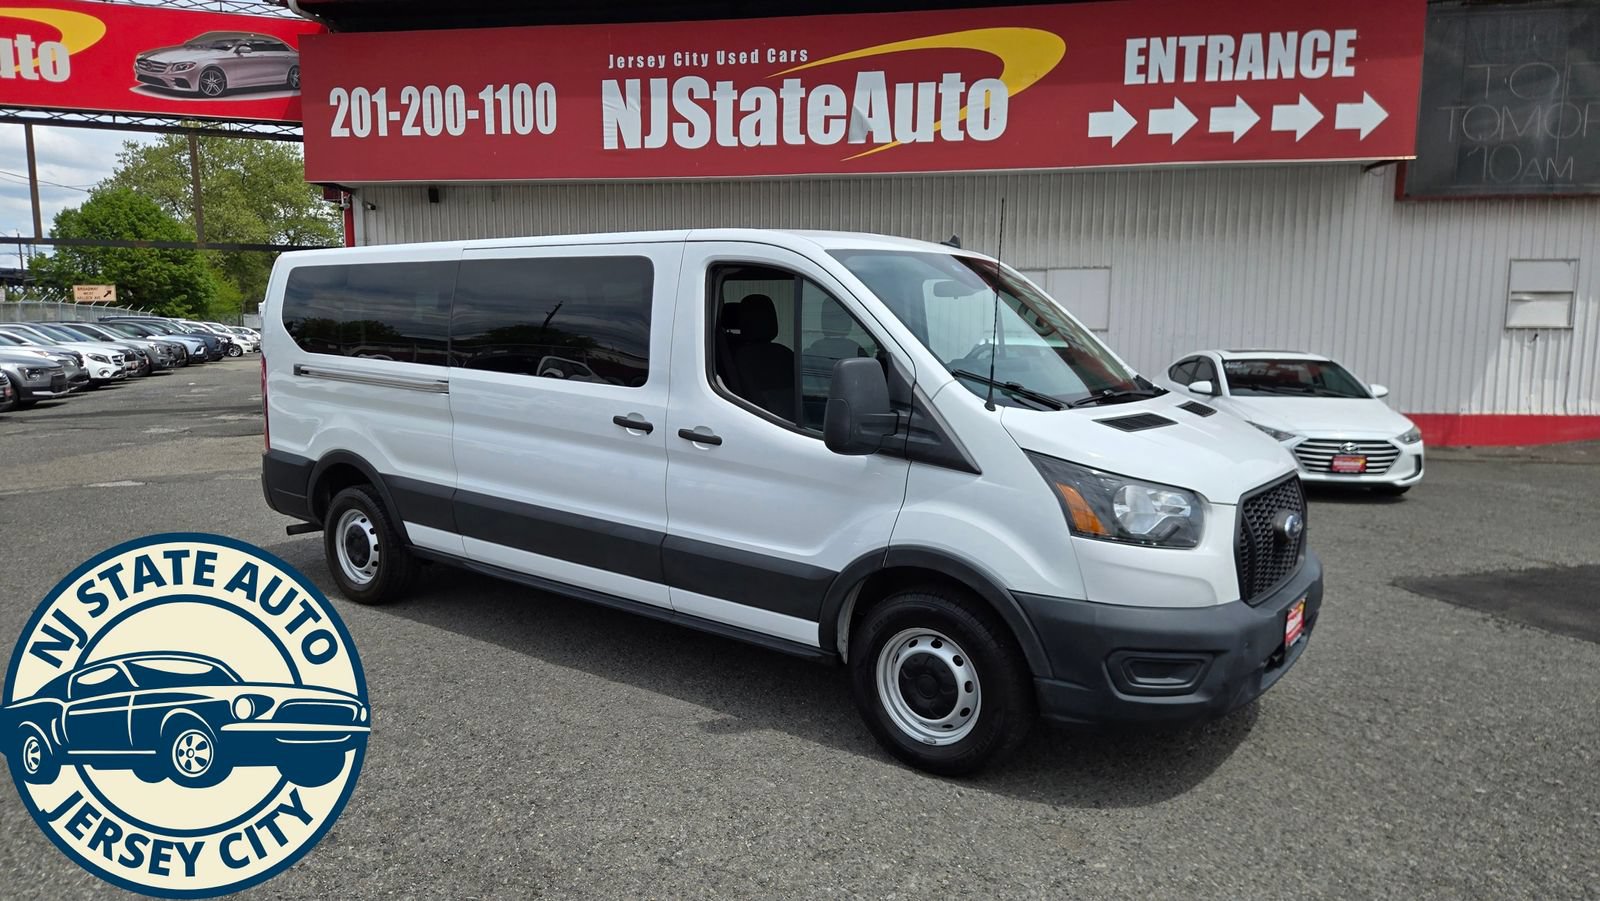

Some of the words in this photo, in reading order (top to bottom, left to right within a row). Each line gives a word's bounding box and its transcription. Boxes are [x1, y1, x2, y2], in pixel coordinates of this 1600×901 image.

[608, 53, 666, 69] Jersey
[673, 51, 709, 67] City
[716, 49, 759, 65] Used
[767, 48, 808, 63] Cars
[1123, 29, 1357, 85] ENTRANCE
[329, 82, 557, 138] 201-200-1100
[601, 70, 1010, 150] NJStateAuto
